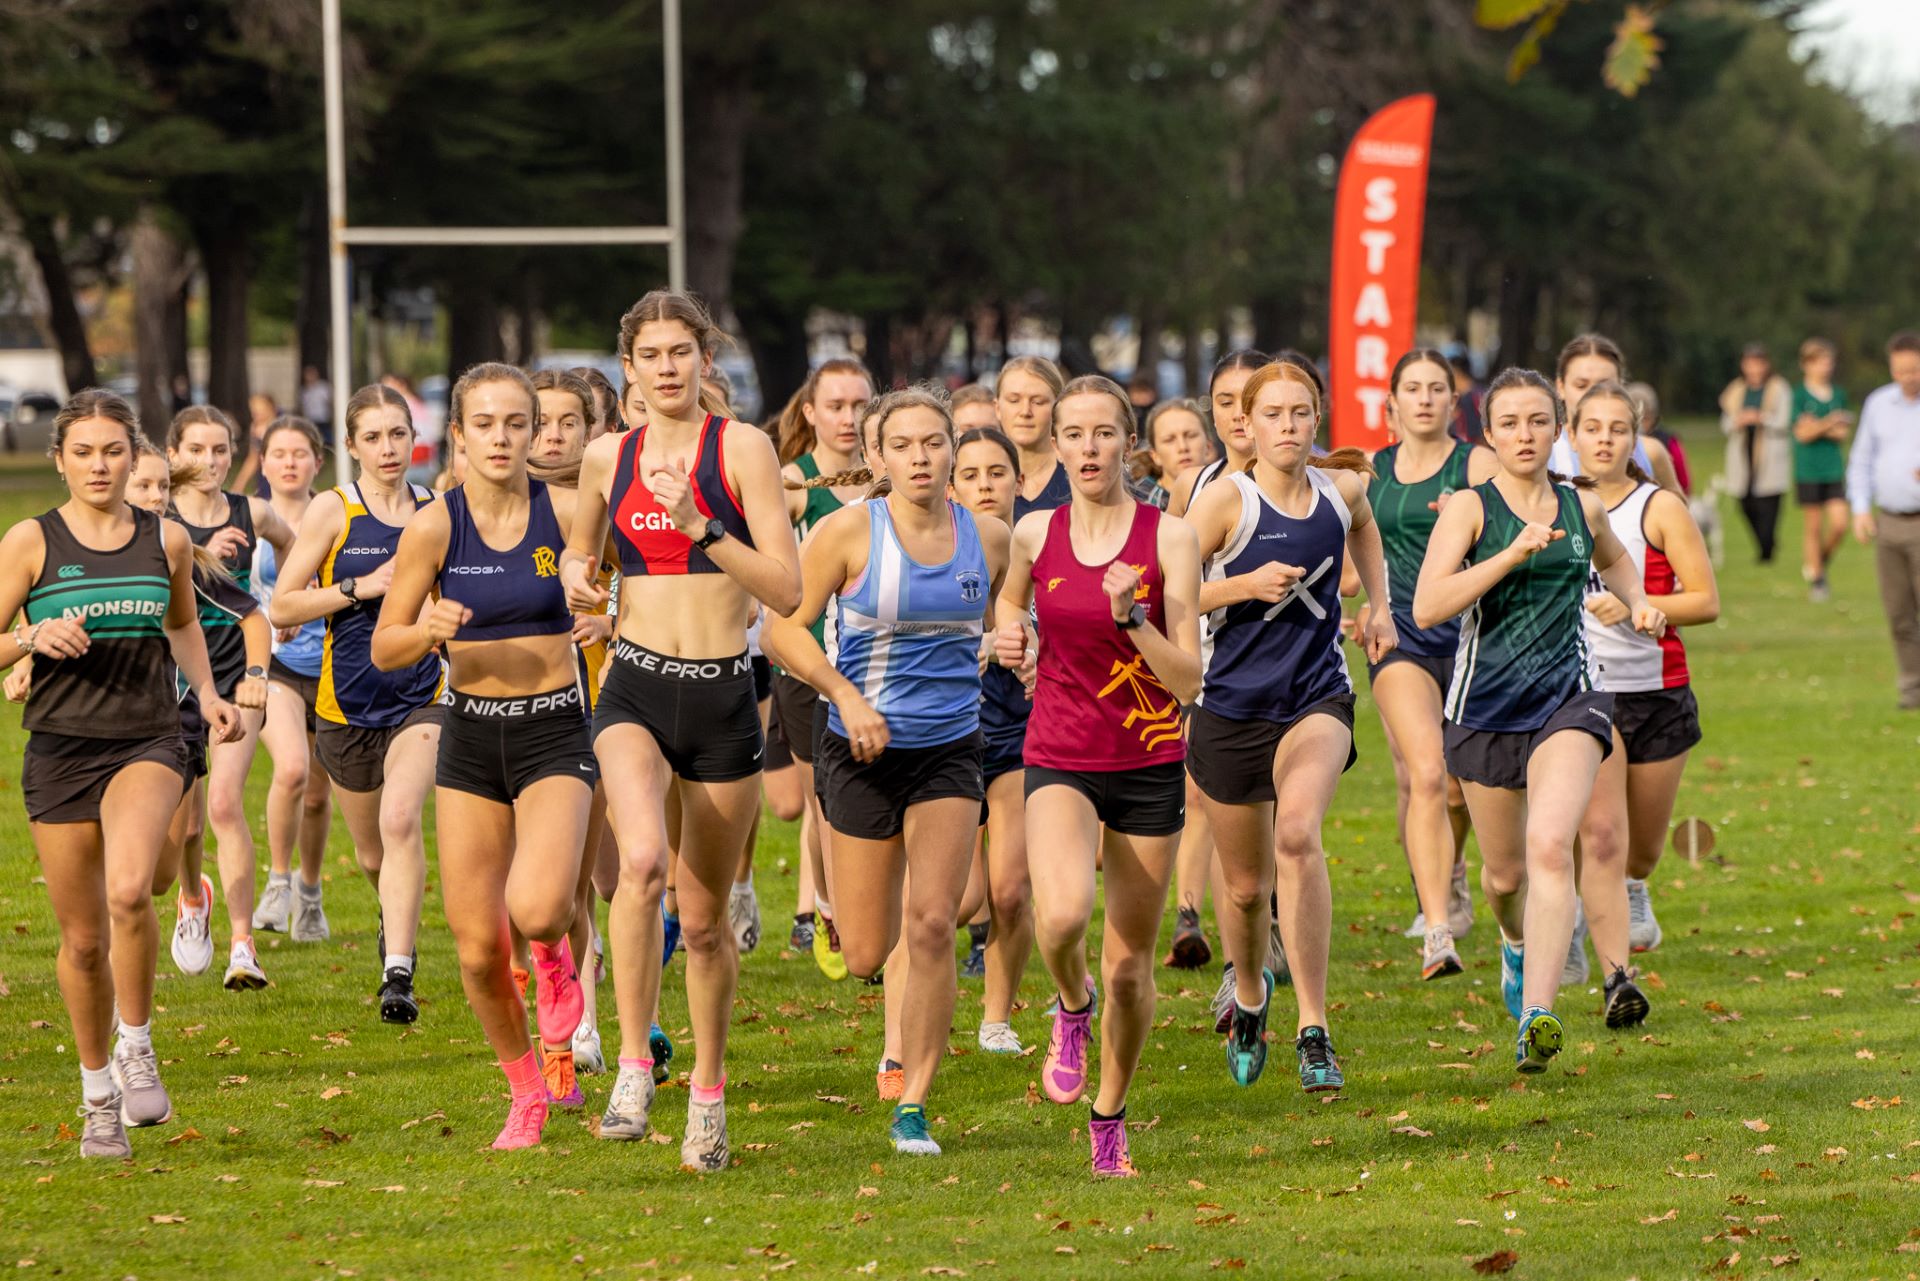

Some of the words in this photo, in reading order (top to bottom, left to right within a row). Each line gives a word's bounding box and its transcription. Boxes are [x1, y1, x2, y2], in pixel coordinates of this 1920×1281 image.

[1354, 176, 1398, 430] START
[343, 547, 389, 556] KOOGA
[448, 565, 505, 575] KOOGA
[62, 599, 165, 623] AVONSIDE
[615, 639, 661, 672] NIKE
[660, 660, 722, 680] PRO
[463, 698, 527, 717] NIKE
[531, 687, 579, 714] PRO
